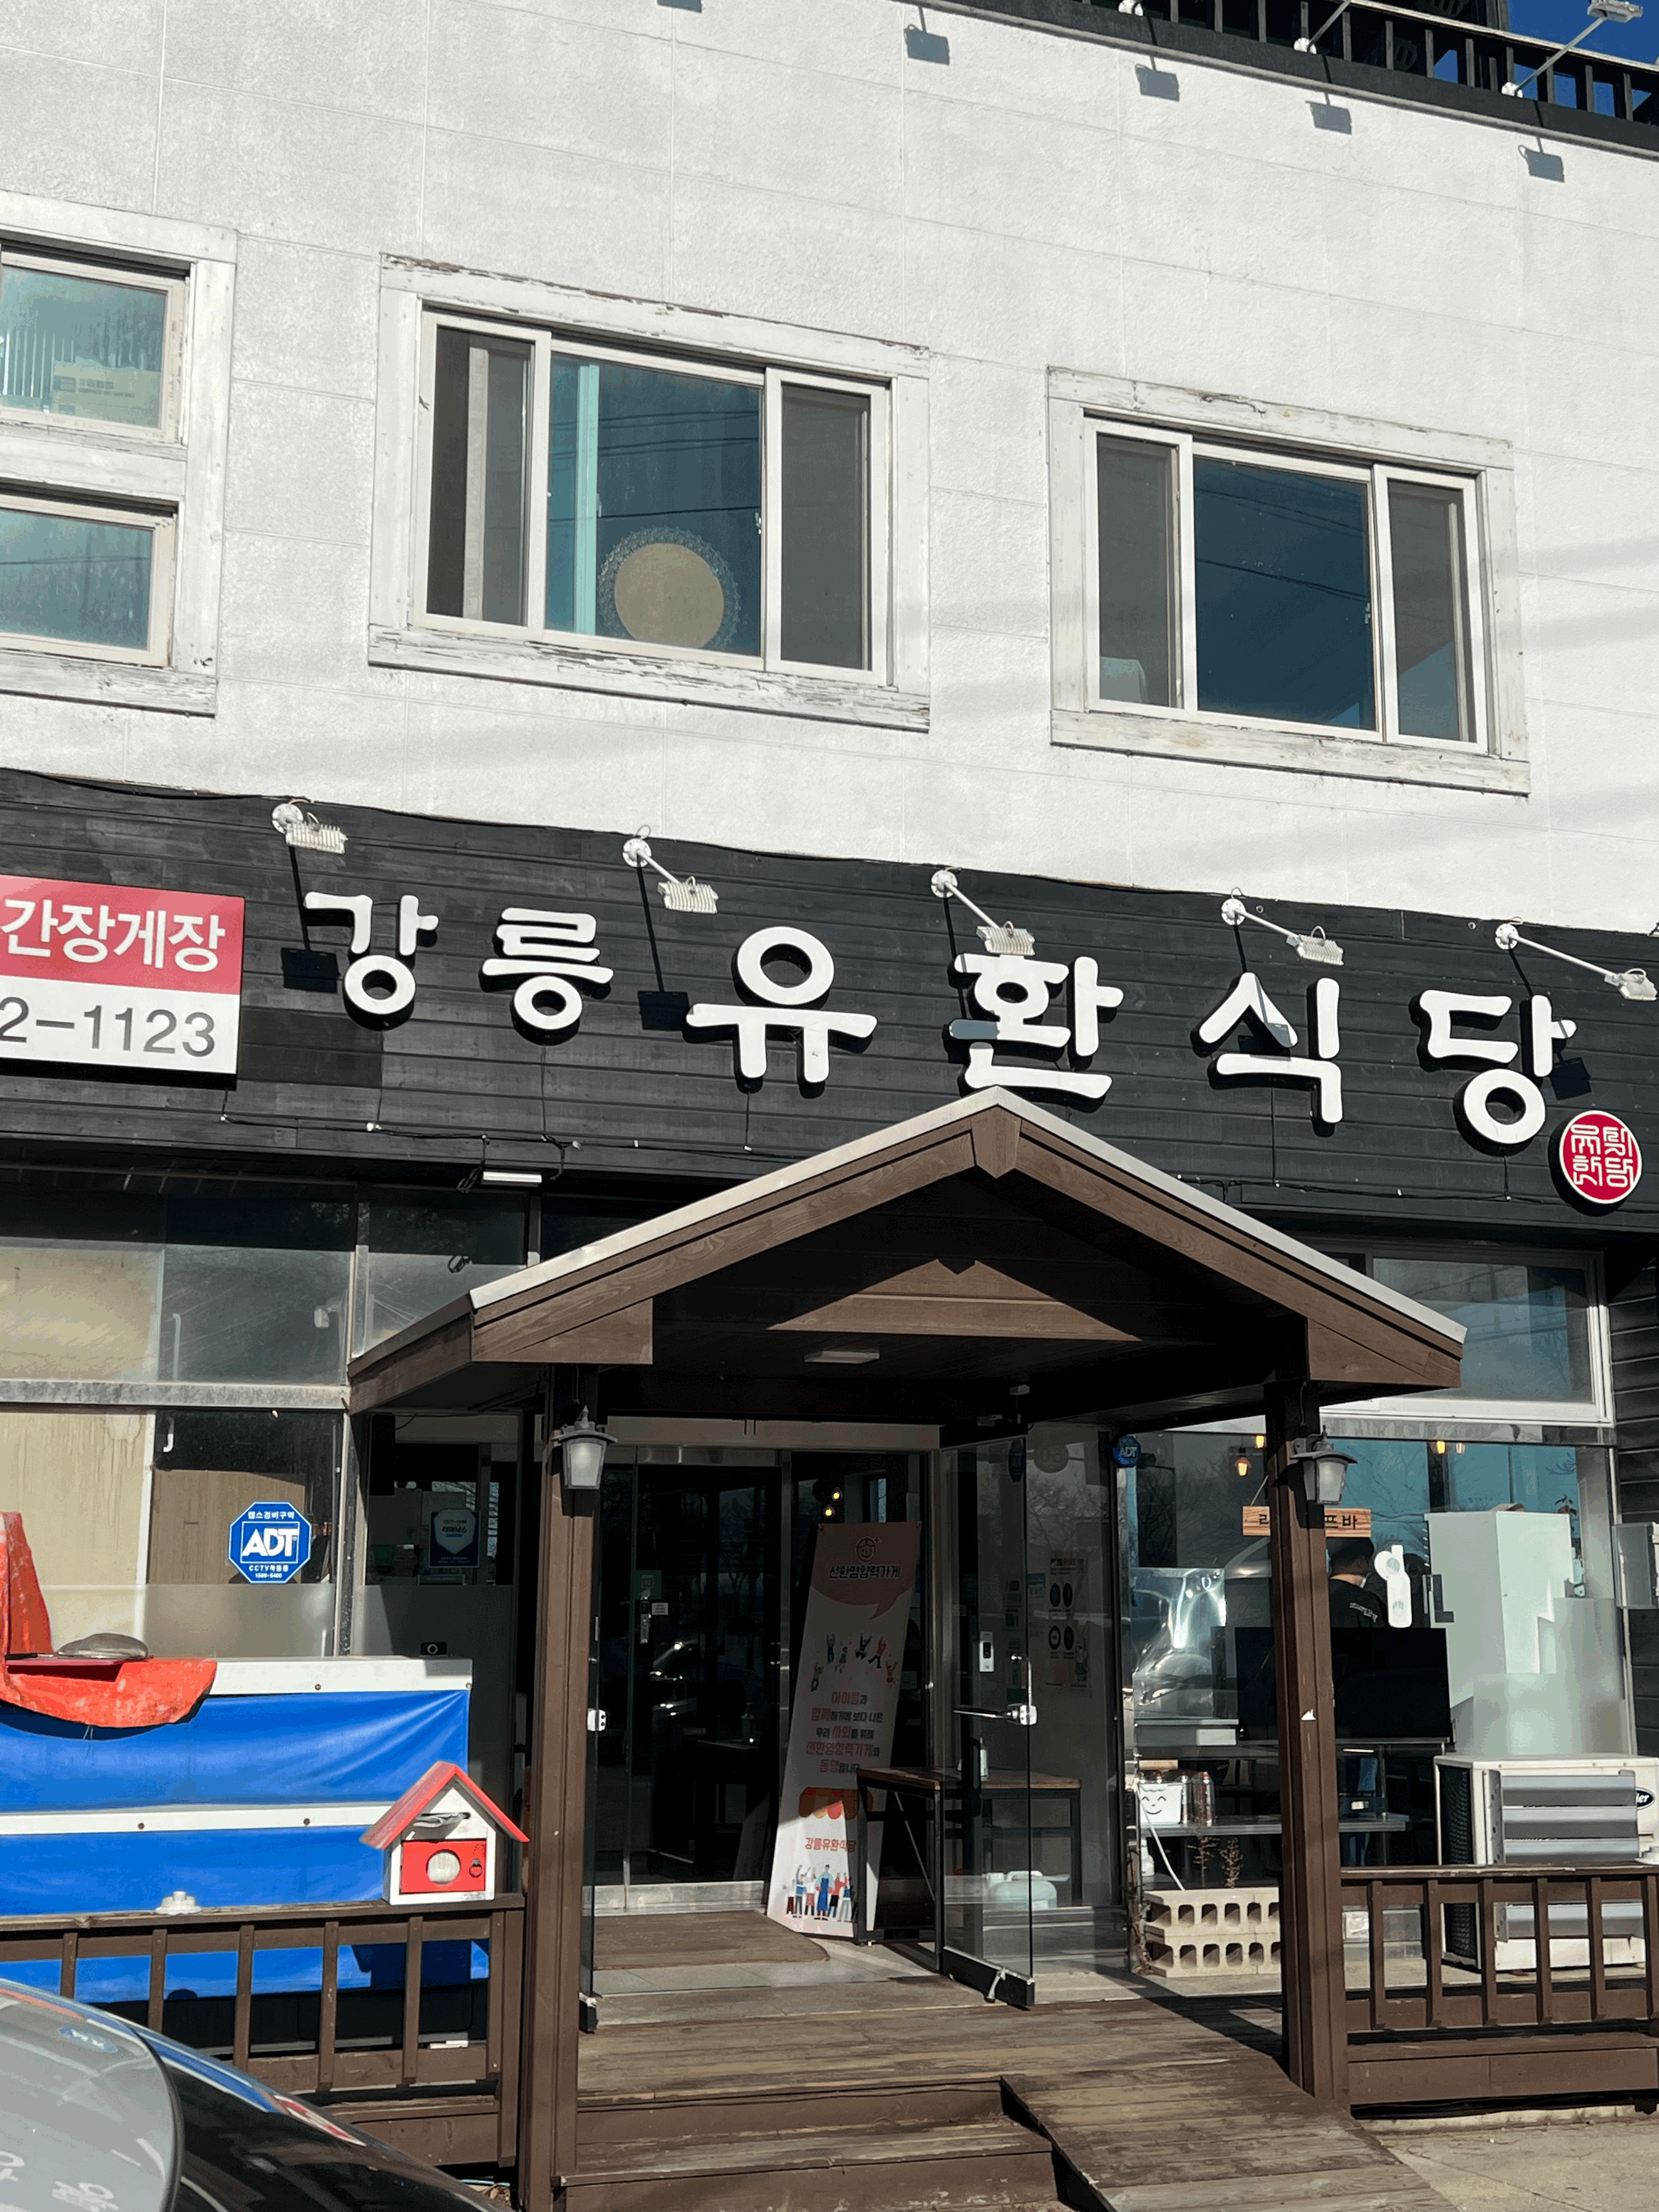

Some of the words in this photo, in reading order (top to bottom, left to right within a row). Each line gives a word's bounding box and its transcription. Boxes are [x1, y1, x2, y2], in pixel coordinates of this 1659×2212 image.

[1, 898, 225, 972] 간장게장
[0, 996, 216, 1058] 2-1123
[1120, 1447, 1137, 1458] ADT
[1324, 1515, 1357, 1530] 프바
[241, 1527, 300, 1557] ADT
[830, 1565, 901, 1579] 선한영향력가게
[831, 1691, 867, 1705] 아이들과
[816, 1727, 830, 1737] 우리
